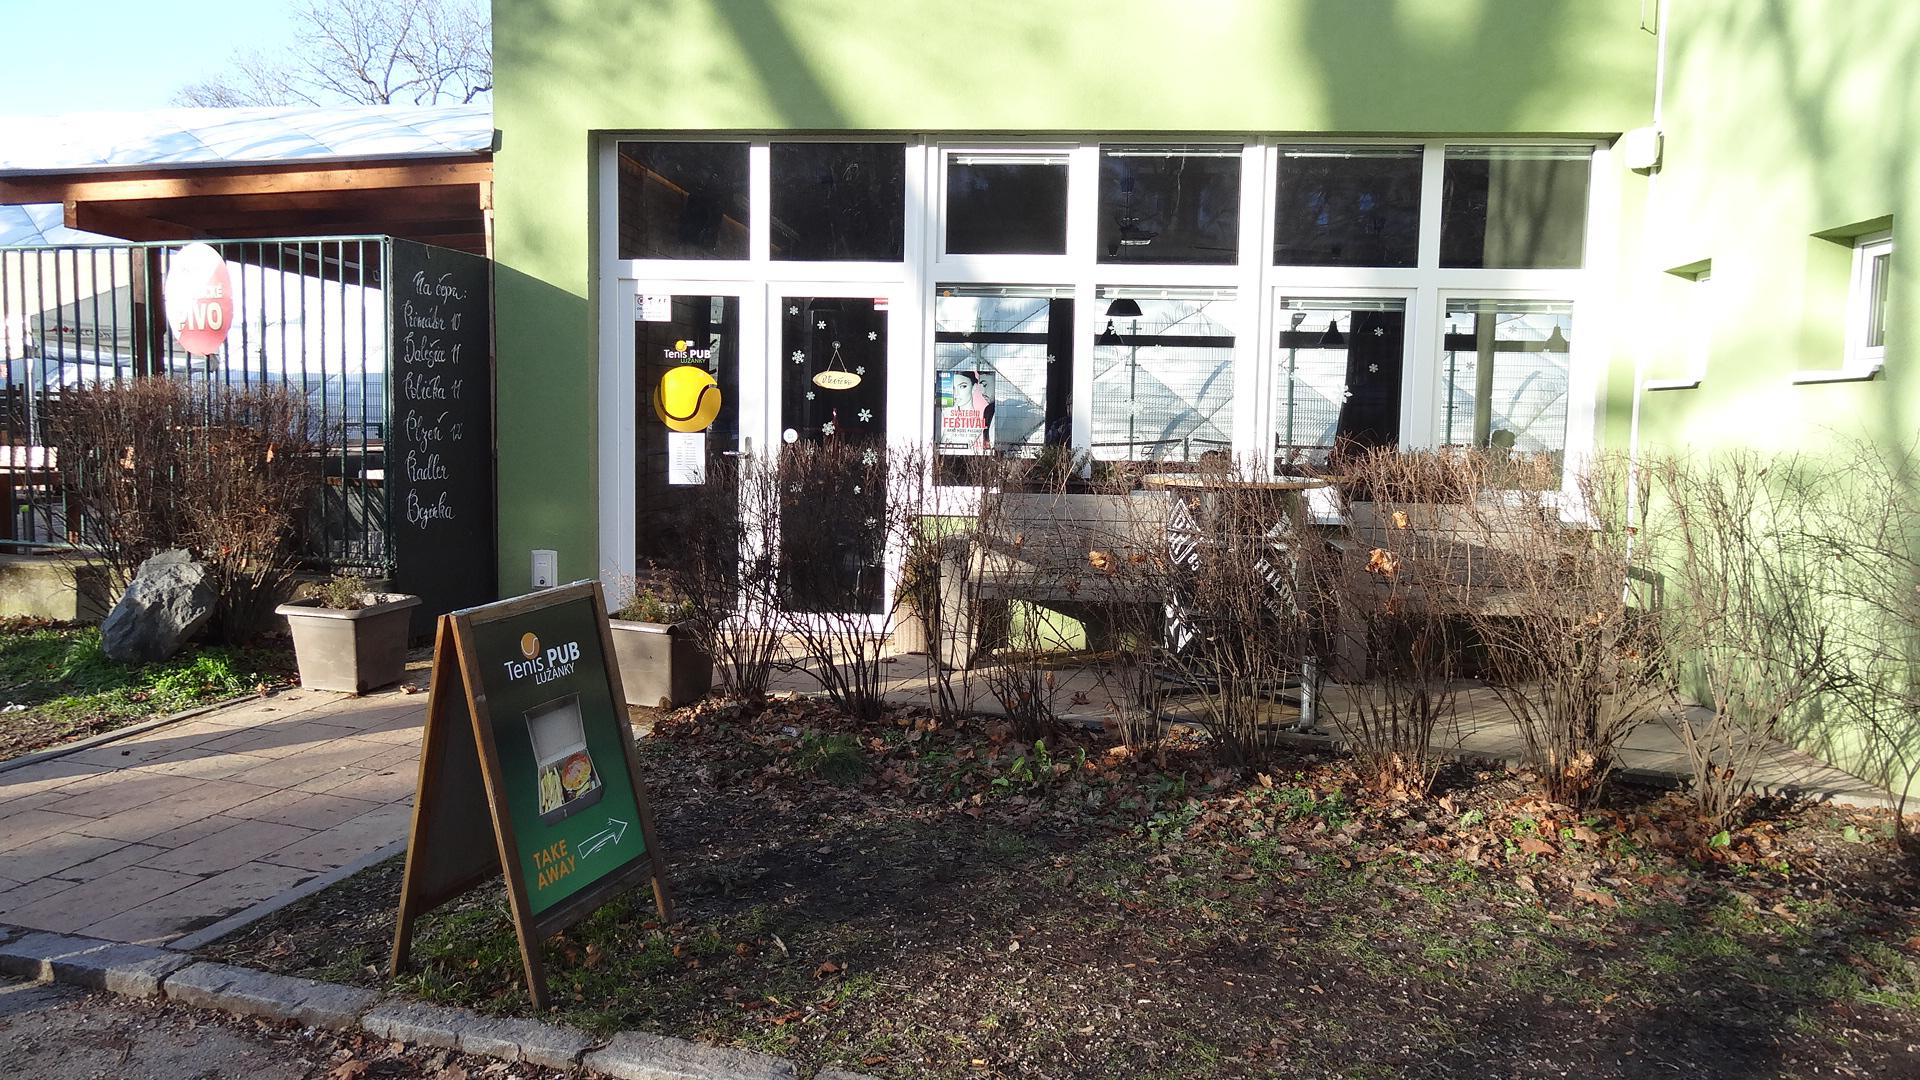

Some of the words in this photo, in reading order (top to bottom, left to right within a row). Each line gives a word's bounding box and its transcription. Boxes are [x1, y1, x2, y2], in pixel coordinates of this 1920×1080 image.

[664, 349, 688, 359] Tenis
[689, 349, 712, 359] PUB
[943, 417, 987, 429] FESTIVAL
[405, 449, 449, 482] Radler
[504, 657, 544, 681] Tenis
[546, 641, 580, 668] PUB
[535, 662, 575, 685] LUŽÁNKY
[533, 839, 567, 870] TAKE
[538, 854, 576, 891] AWAY
